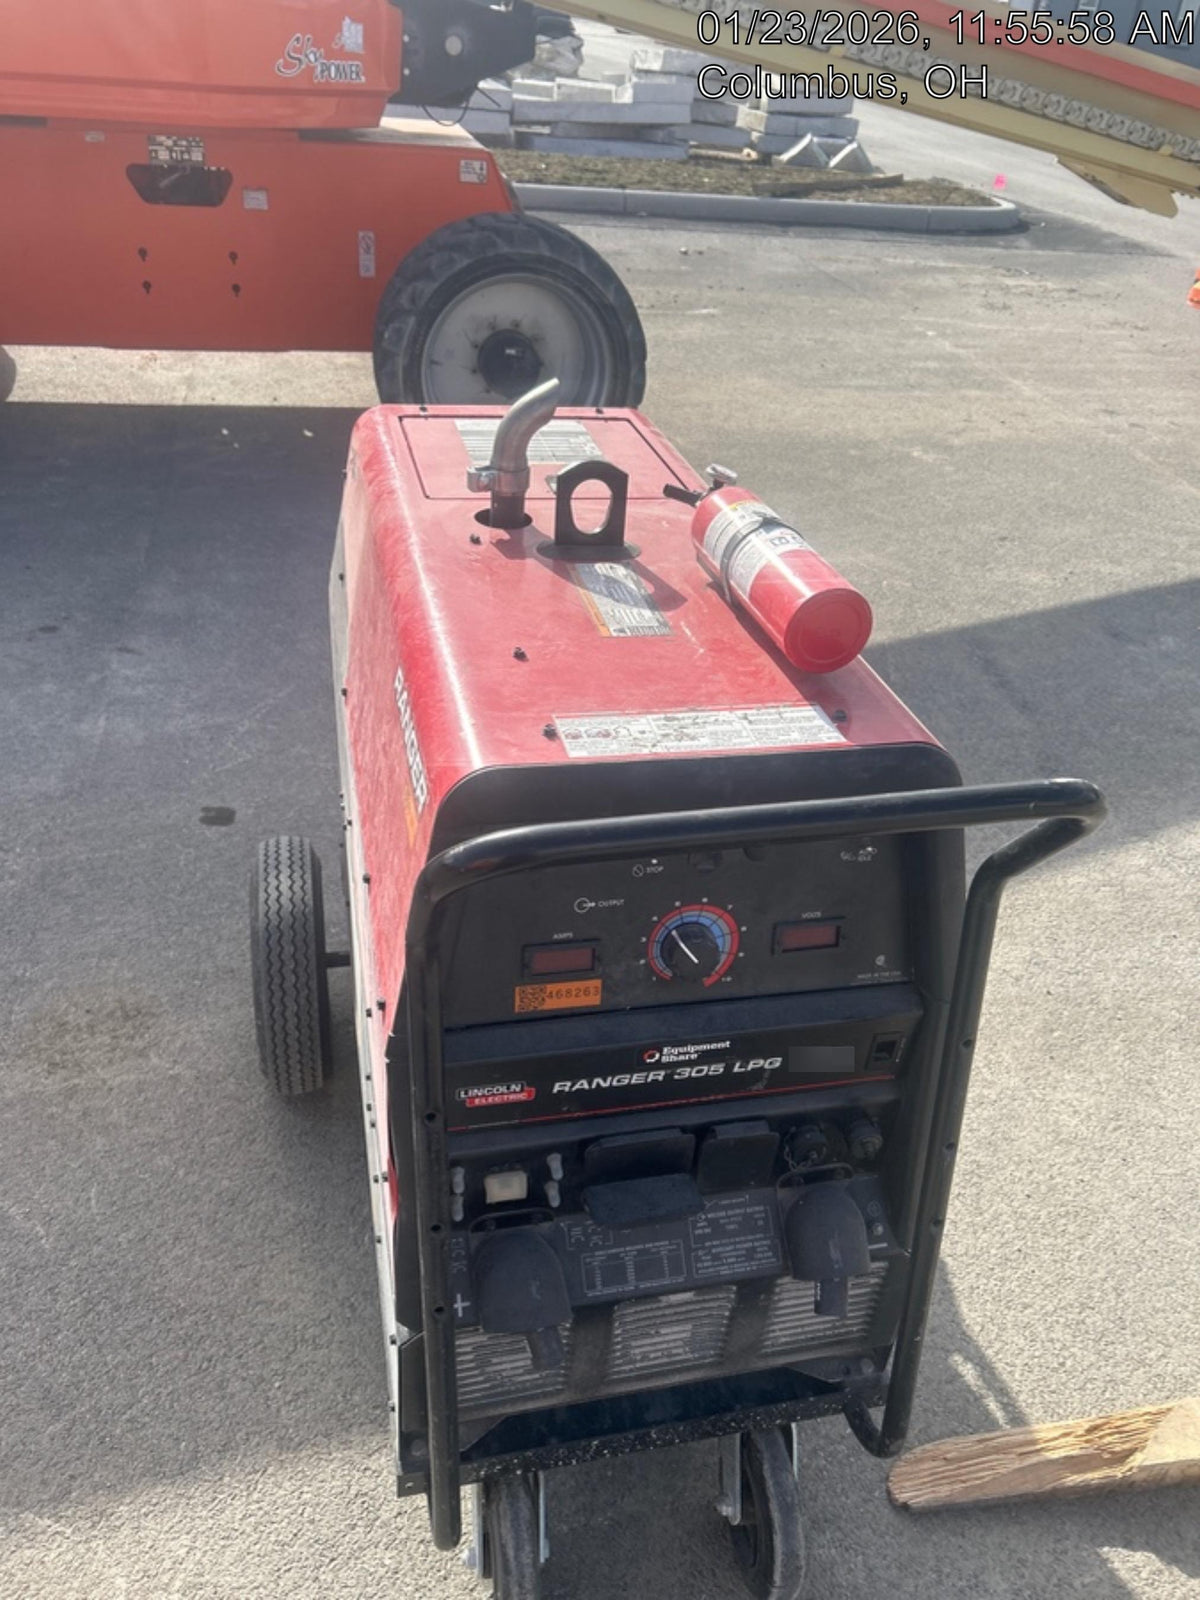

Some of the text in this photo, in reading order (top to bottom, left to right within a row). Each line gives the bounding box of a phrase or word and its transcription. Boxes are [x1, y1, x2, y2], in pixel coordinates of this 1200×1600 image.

[546, 986, 600, 999] 468263
[662, 1040, 731, 1056] Equipment
[660, 1052, 699, 1063] Share
[552, 1057, 783, 1094] RANGER 305 LPG
[459, 1083, 523, 1099] LINCOLN
[473, 1092, 529, 1105] ELECTRIC
